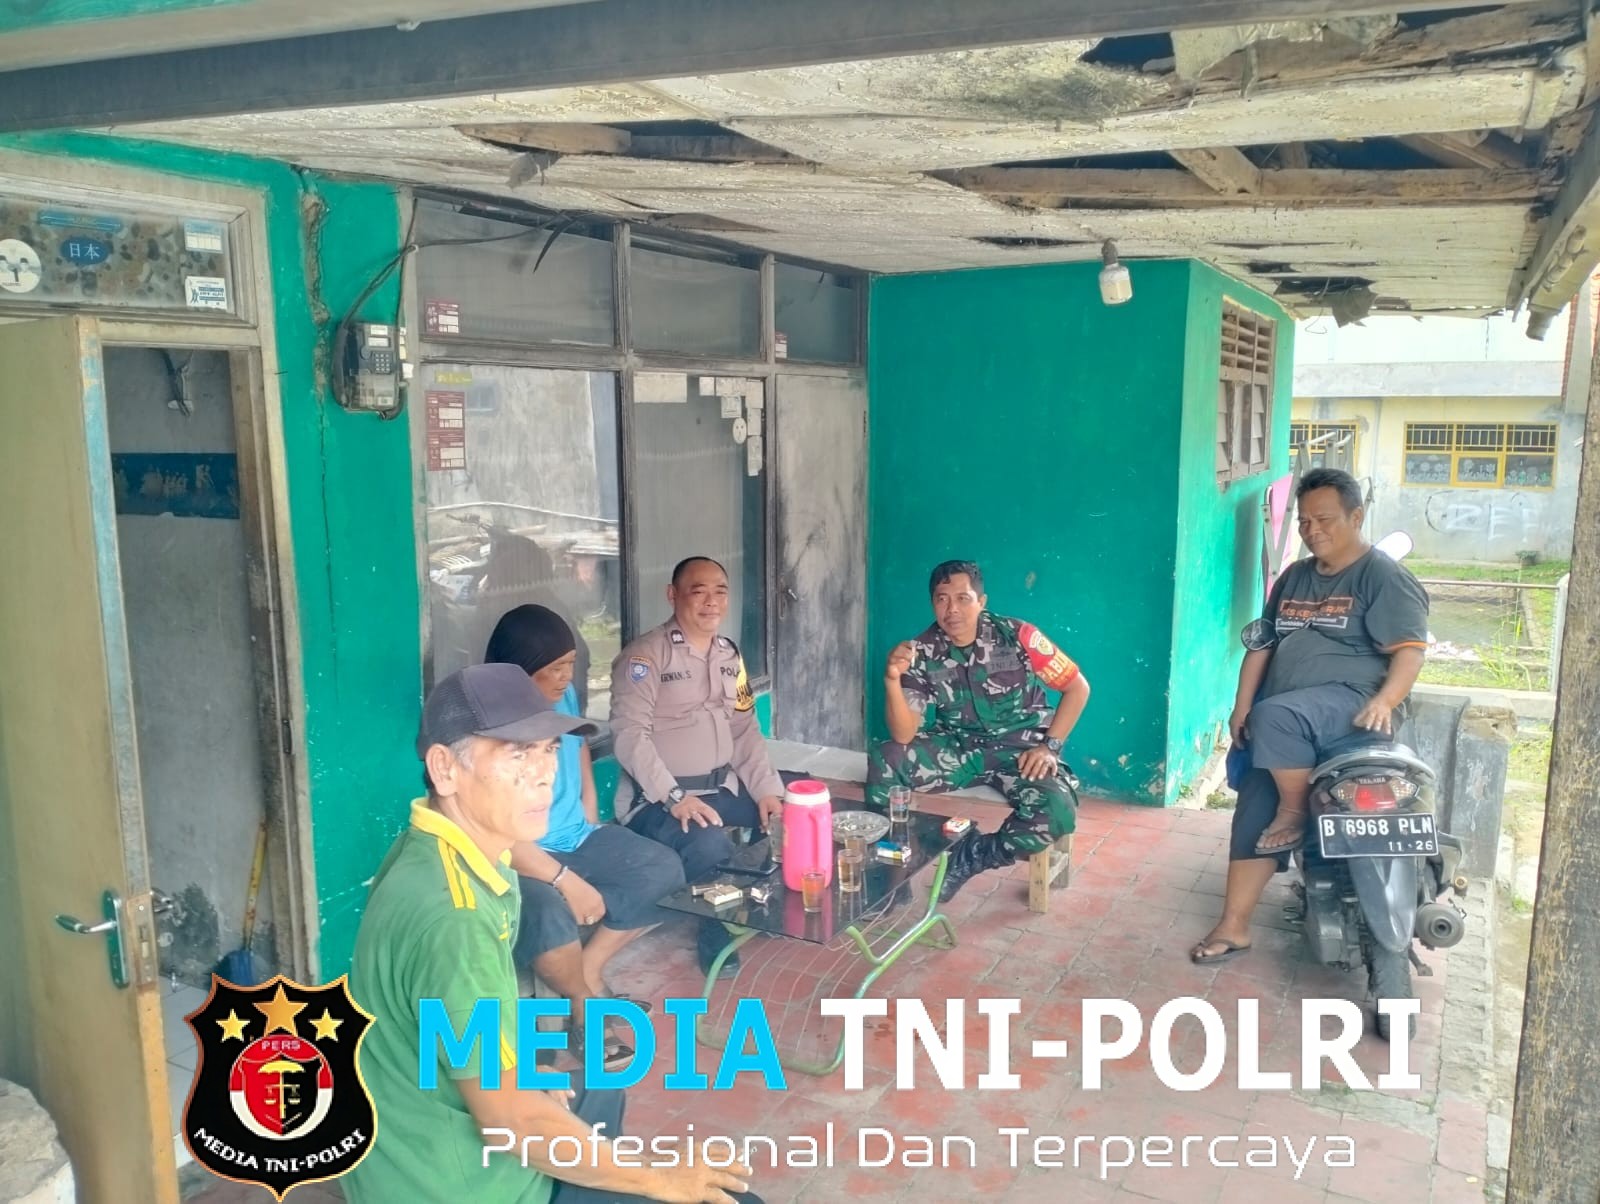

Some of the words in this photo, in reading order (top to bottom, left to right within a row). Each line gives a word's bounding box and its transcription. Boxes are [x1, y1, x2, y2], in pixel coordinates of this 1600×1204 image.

[69, 242, 100, 260] 日本
[1323, 819, 1335, 837] B
[1345, 818, 1389, 836] 6968
[1398, 816, 1433, 834] PLN
